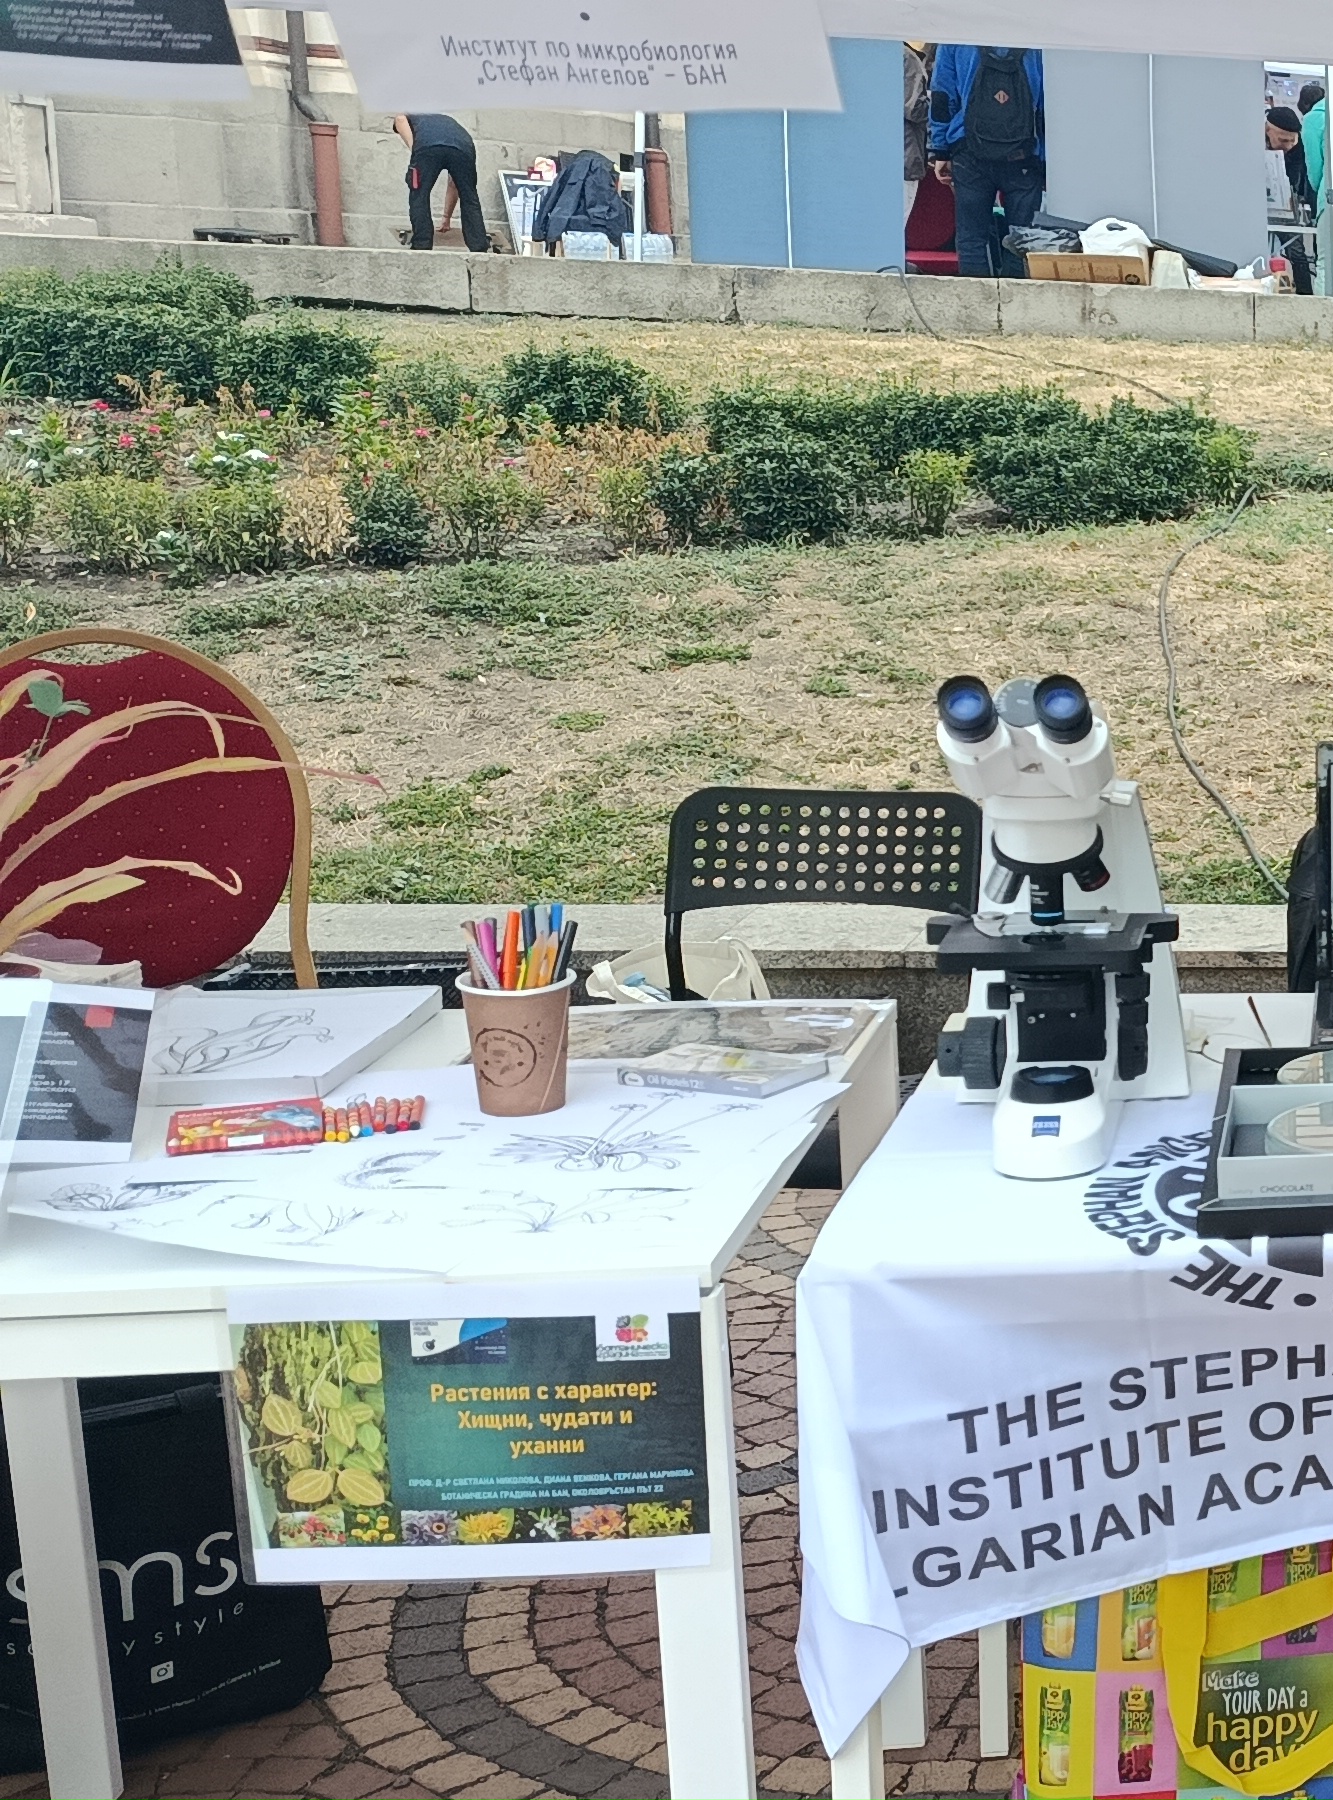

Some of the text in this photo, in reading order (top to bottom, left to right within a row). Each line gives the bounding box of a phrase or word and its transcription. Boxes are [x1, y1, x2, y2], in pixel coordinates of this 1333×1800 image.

[441, 36, 738, 64] Институт по микробиология
[477, 59, 559, 85] „Стефан
[683, 64, 727, 85] БАН
[647, 1074, 659, 1085] Oil
[660, 1075, 689, 1088] Pastels
[1260, 1184, 1314, 1193] CHOCOLATE
[1083, 1172, 1186, 1257] STEPHAN
[1169, 1244, 1283, 1311] THE
[431, 1381, 658, 1403] Растения с характер:
[458, 1409, 633, 1431] Хищни, чудати и
[947, 1382, 1085, 1455] THE
[510, 1438, 585, 1459] уханни
[453, 1477, 494, 1487] СВЕТЛАНА
[872, 1410, 1226, 1534] INSTITUTE
[441, 1490, 498, 1501] БОТАНИЧЕСКА
[500, 1489, 537, 1500] ГРАДИНА
[539, 1488, 550, 1498] НА
[894, 1485, 1176, 1598] GARIAN
[154, 1601, 245, 1645] style
[1202, 1669, 1260, 1692] Make
[1222, 1686, 1308, 1716] YOUR DAY a
[1207, 1709, 1319, 1747] happy
